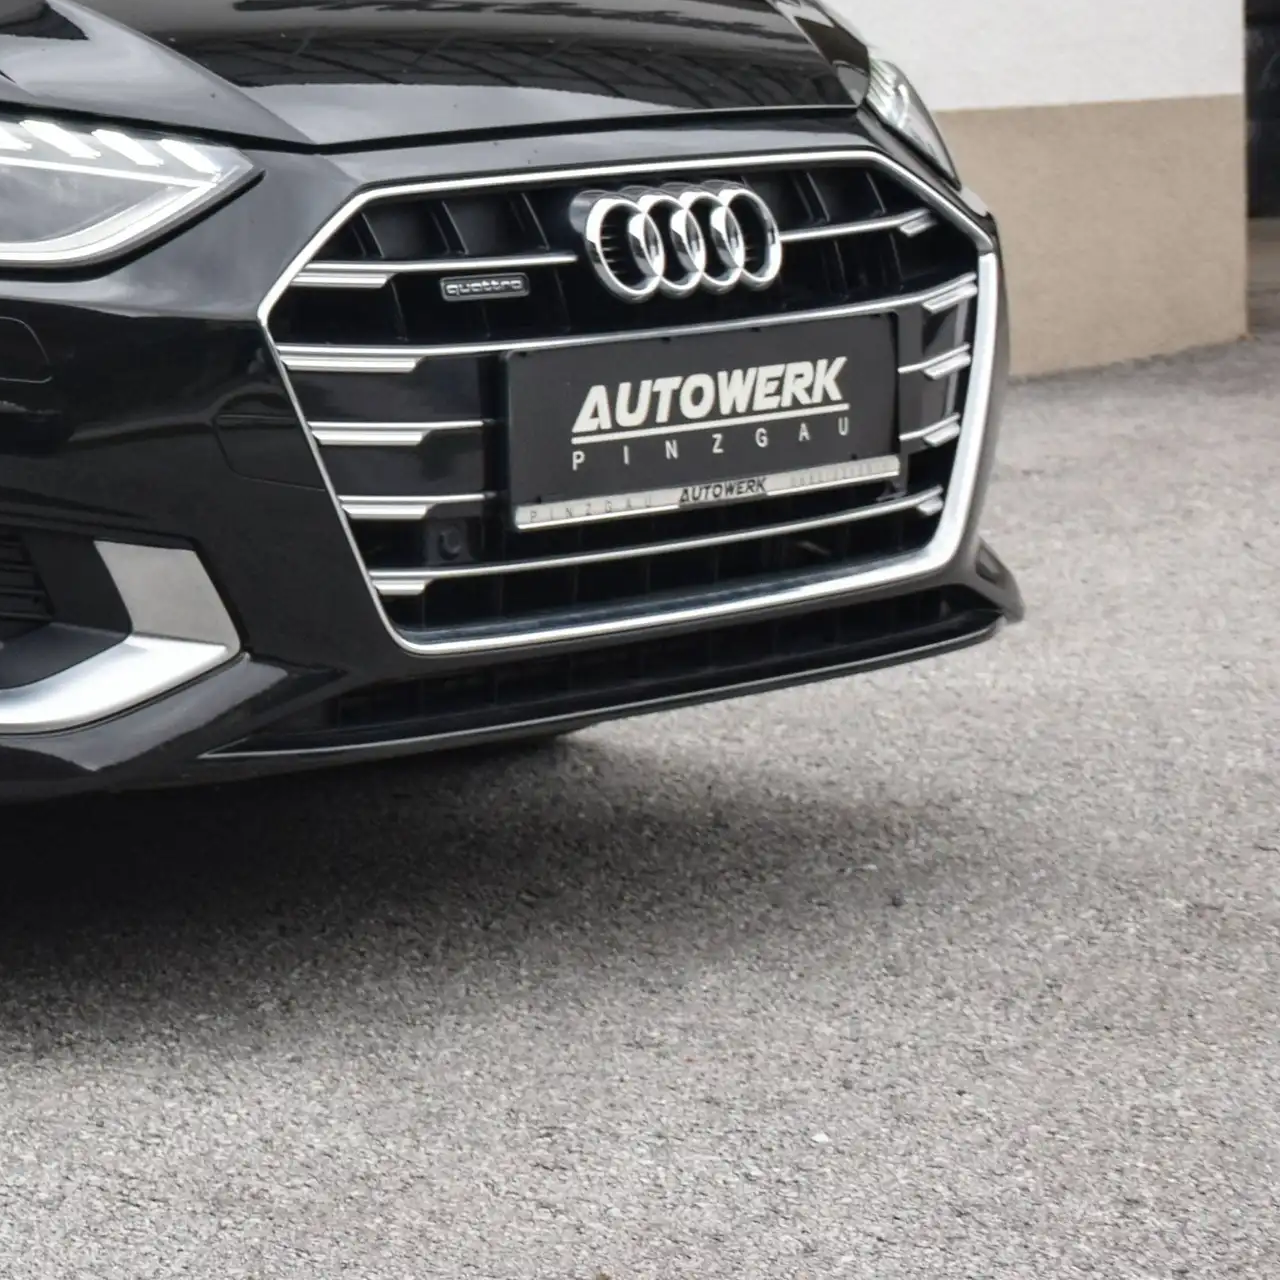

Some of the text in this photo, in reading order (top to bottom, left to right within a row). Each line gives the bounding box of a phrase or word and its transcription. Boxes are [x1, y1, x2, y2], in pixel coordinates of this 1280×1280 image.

[446, 280, 522, 297] quattro
[571, 355, 848, 433] AUTOWERK
[678, 476, 768, 504] AUTOWERK
